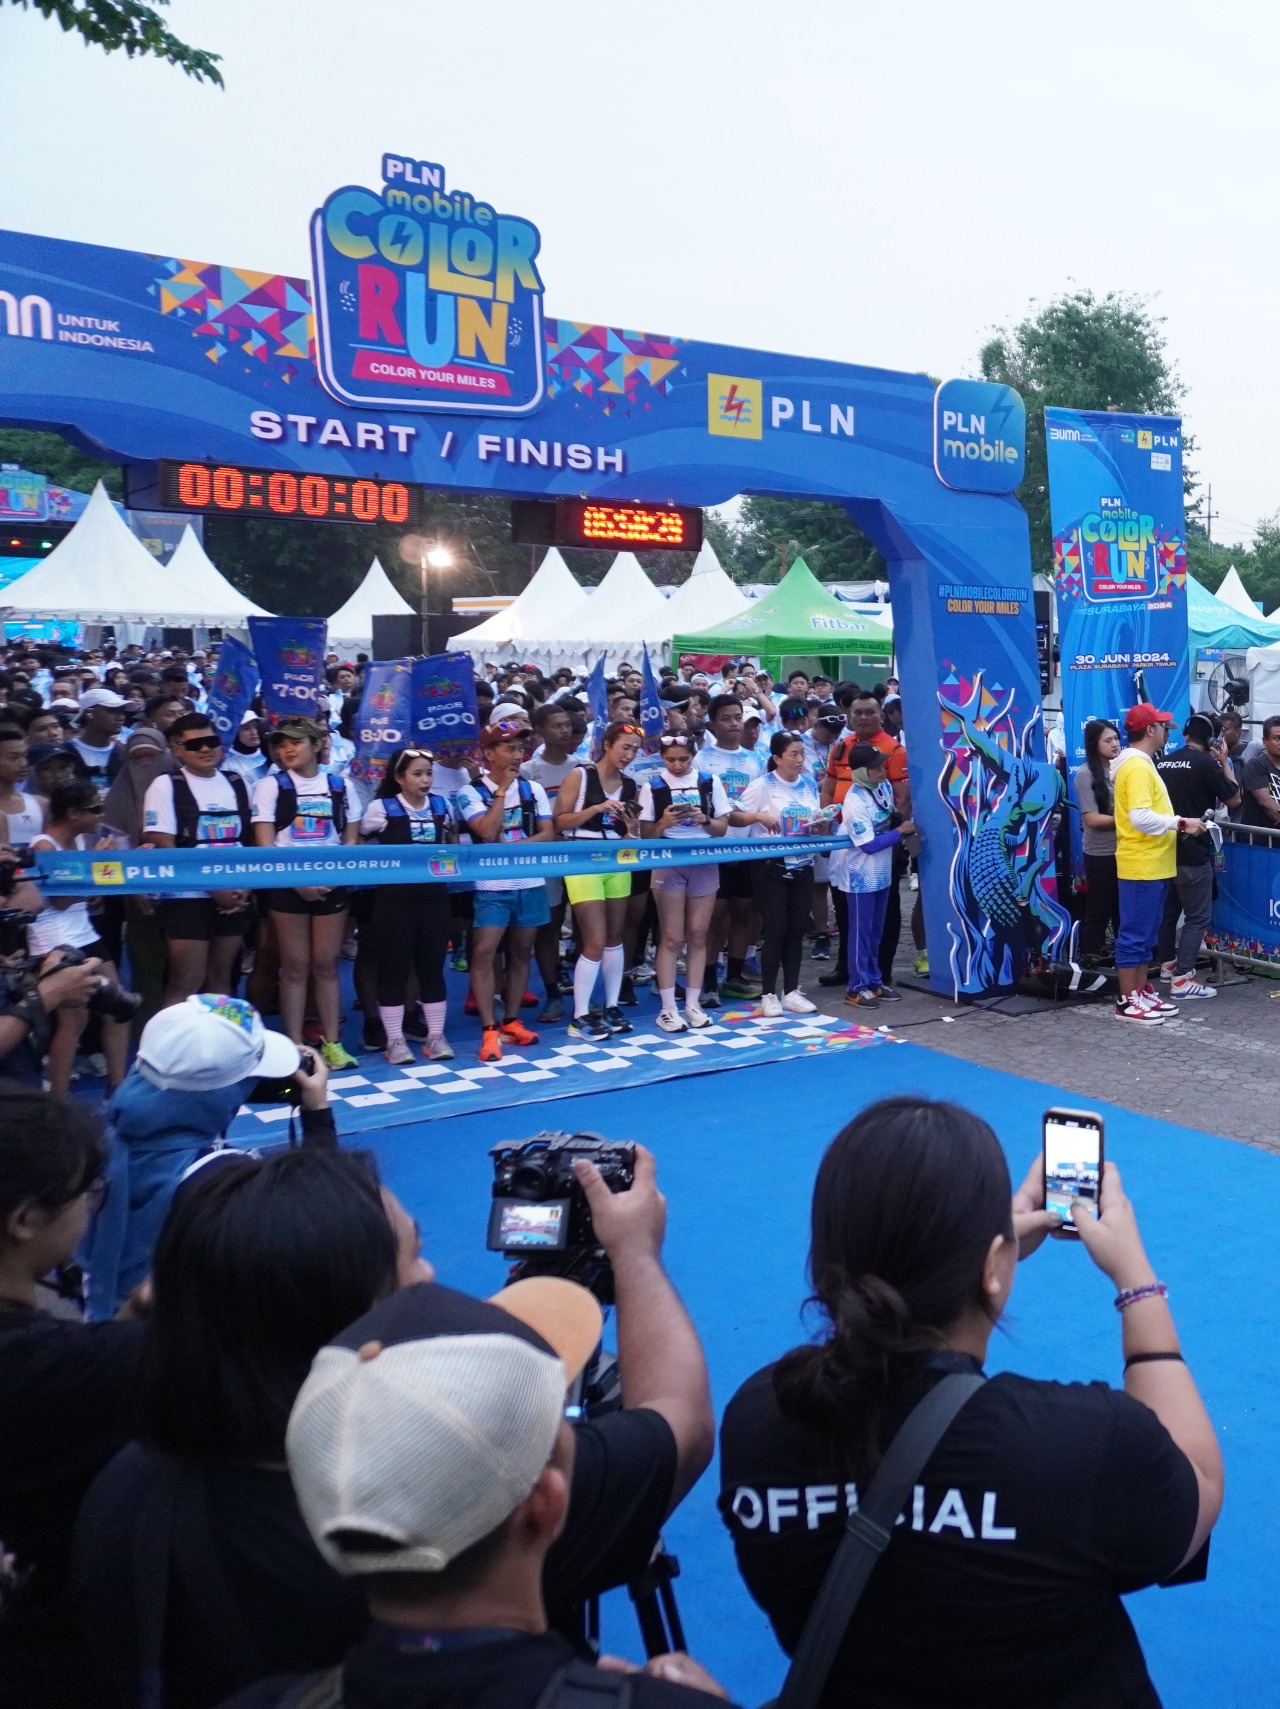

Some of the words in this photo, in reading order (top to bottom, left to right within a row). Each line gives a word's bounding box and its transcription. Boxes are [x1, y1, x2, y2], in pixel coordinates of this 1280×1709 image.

[386, 158, 441, 188] PLN
[387, 188, 493, 226] mobile
[326, 190, 541, 304] COLOR
[57, 313, 121, 332] UNTUK
[357, 263, 509, 368] RUN
[58, 330, 155, 353] INDONESIA
[369, 362, 417, 379] COLOR
[418, 366, 455, 384] YOUR
[457, 371, 497, 389] MILES
[771, 395, 855, 436] PLN
[943, 410, 986, 435] PLN
[249, 410, 416, 453] START
[477, 433, 624, 473] FINISH
[1049, 427, 1080, 442] BUMN
[1153, 435, 1178, 447] PLN
[943, 437, 1019, 465] mobile
[177, 463, 410, 524] 00:00:00
[1100, 497, 1121, 507] PLN
[1101, 507, 1139, 520] mobile
[1081, 513, 1157, 551] COLOR
[1093, 543, 1146, 584] RUN
[938, 584, 1028, 602] #PLNMOBILECOLORRUN
[947, 598, 973, 613] COLOR
[975, 600, 995, 614] YOUR
[996, 602, 1020, 615] MILES
[1087, 603, 1146, 615] SURABAYA
[1147, 601, 1173, 610] 2024
[810, 617, 870, 632] Fitbar
[1075, 654, 1096, 665] 30
[1099, 653, 1131, 664] JUNI
[1133, 652, 1170, 663] 2024
[427, 701, 464, 713] PACE
[417, 712, 476, 731] 8:00
[1157, 760, 1192, 770] OFFICIAL
[478, 857, 509, 867] COLOR
[513, 856, 537, 865] YOUR
[541, 854, 569, 864] MILES
[639, 848, 673, 861] PLN
[125, 864, 176, 880] PLN
[200, 859, 401, 875] #PLNMOBILECOLORRUN
[732, 1482, 1018, 1541] OFFIIAL
